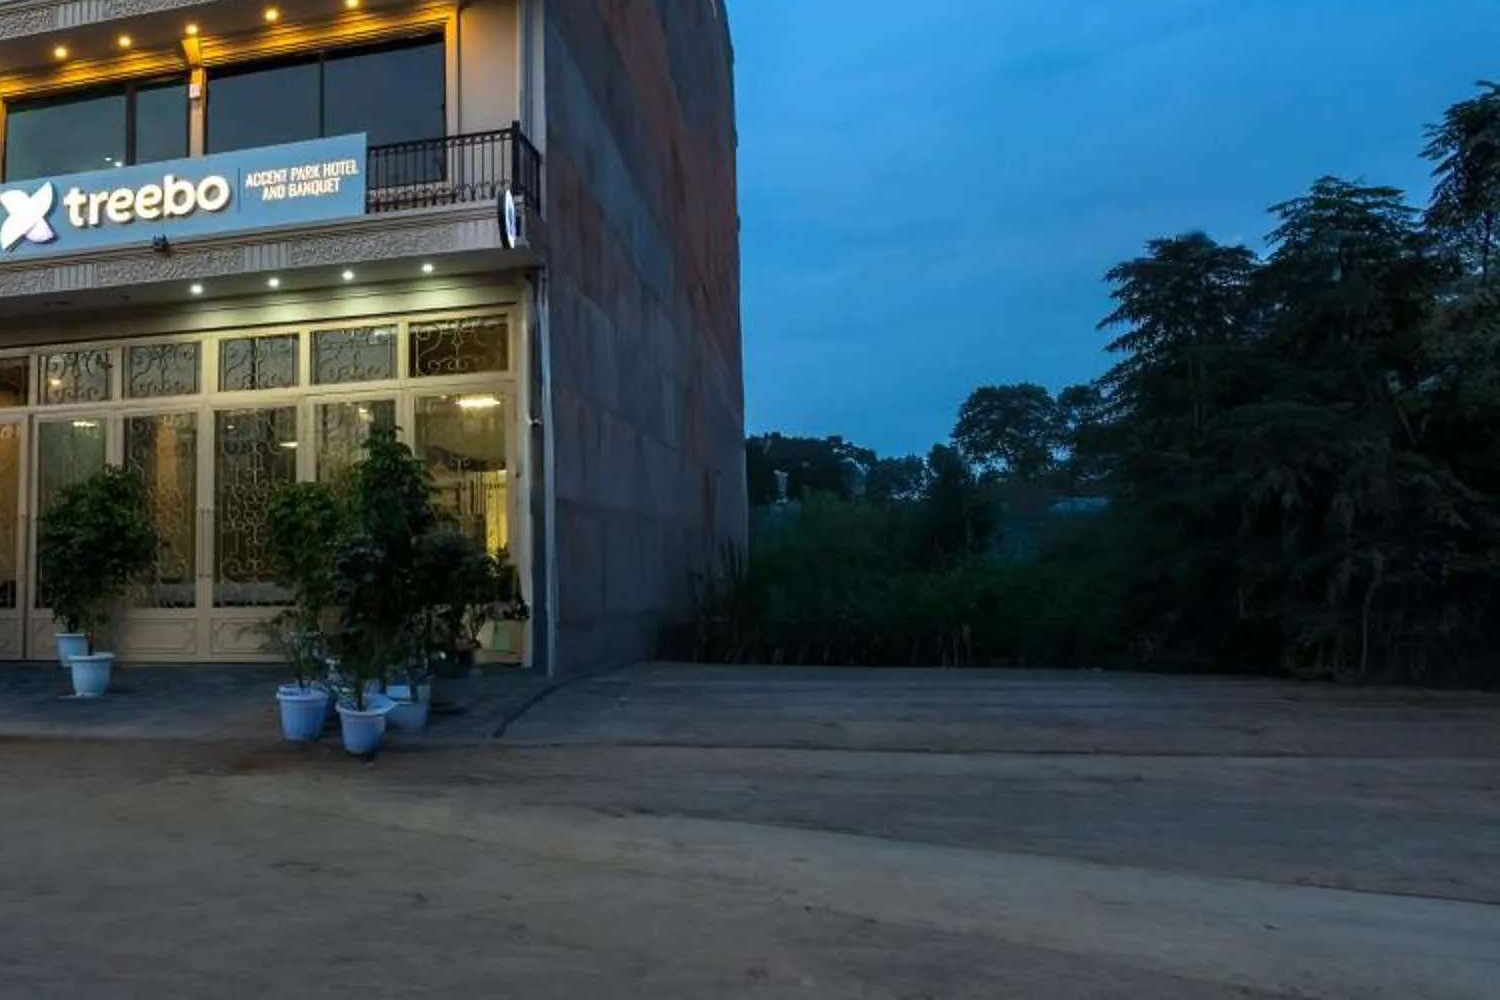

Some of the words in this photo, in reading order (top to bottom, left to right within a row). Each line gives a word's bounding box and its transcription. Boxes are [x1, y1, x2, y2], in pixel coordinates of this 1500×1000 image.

[245, 168, 289, 188] ACCENT
[291, 163, 321, 181] PARK
[323, 159, 359, 178] HOTEL
[63, 173, 230, 227] treebo
[262, 183, 285, 201] AND
[288, 178, 340, 198] BANQUET
